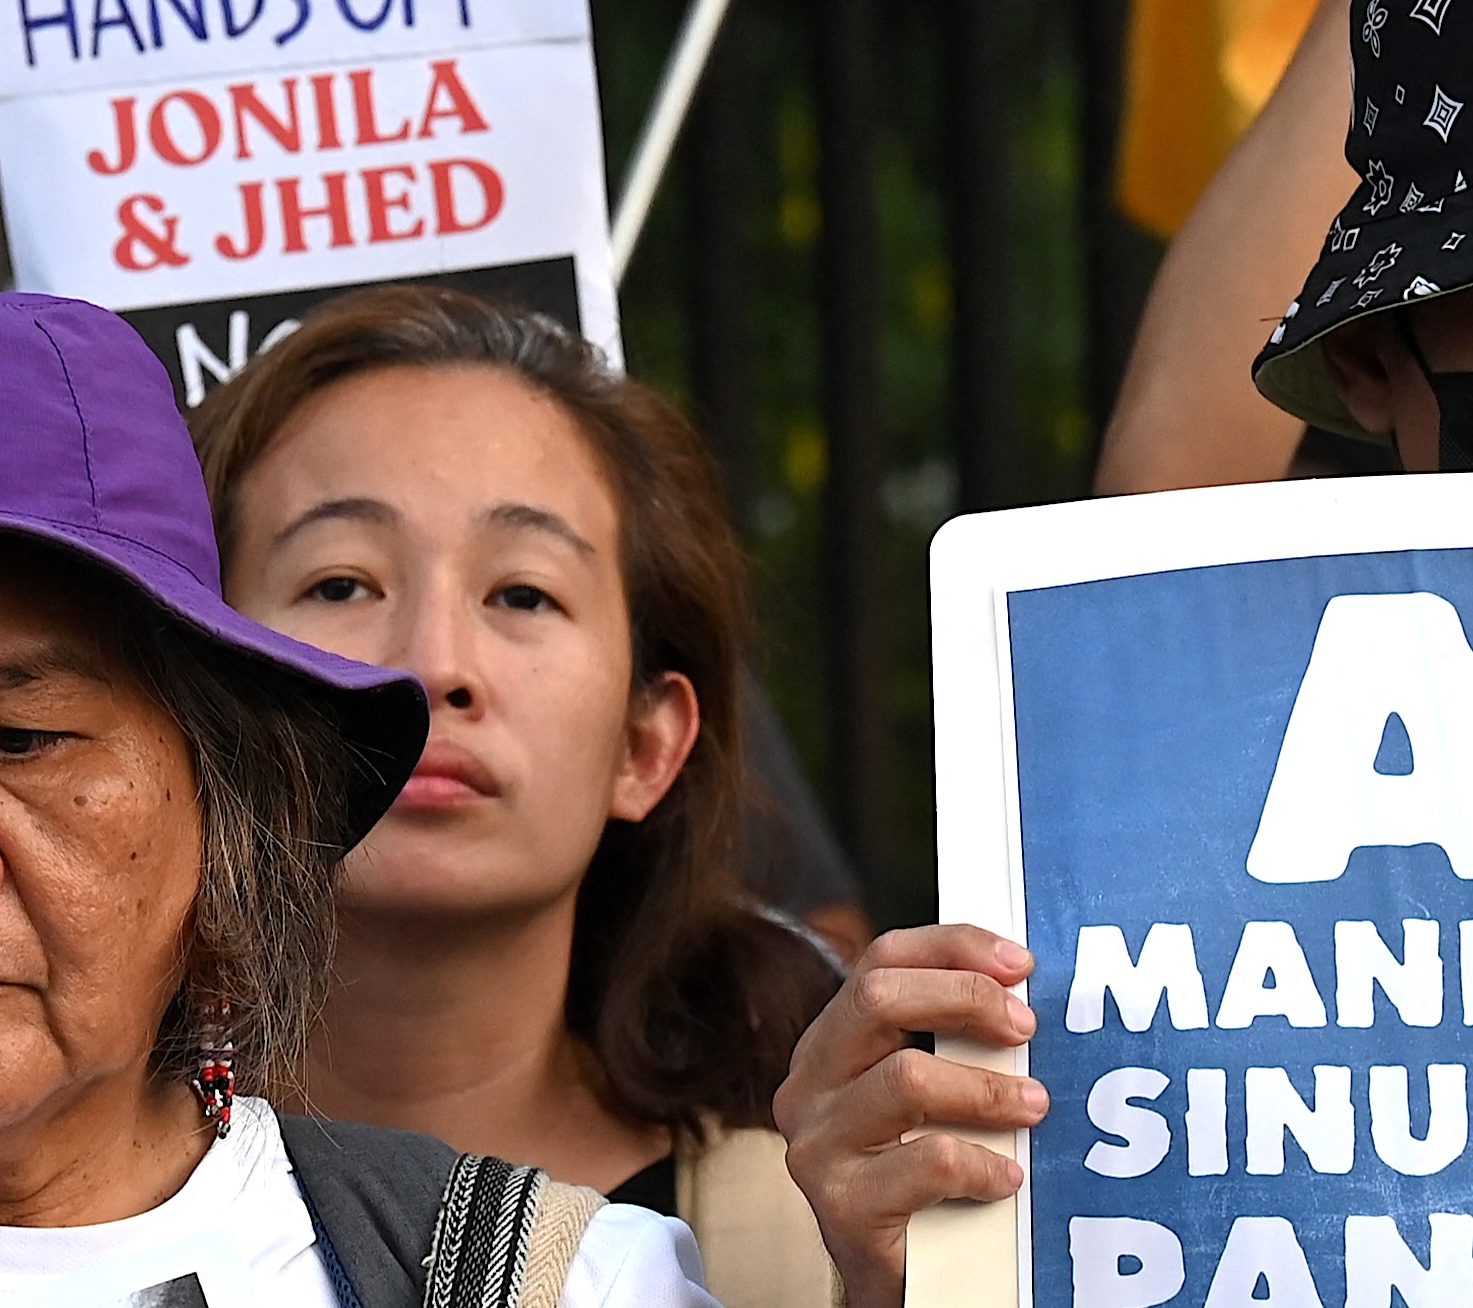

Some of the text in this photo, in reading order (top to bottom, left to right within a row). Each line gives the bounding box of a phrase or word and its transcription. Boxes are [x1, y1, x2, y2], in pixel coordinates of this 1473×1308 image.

[86, 58, 490, 177] JONILA
[111, 156, 507, 274] & JHED
